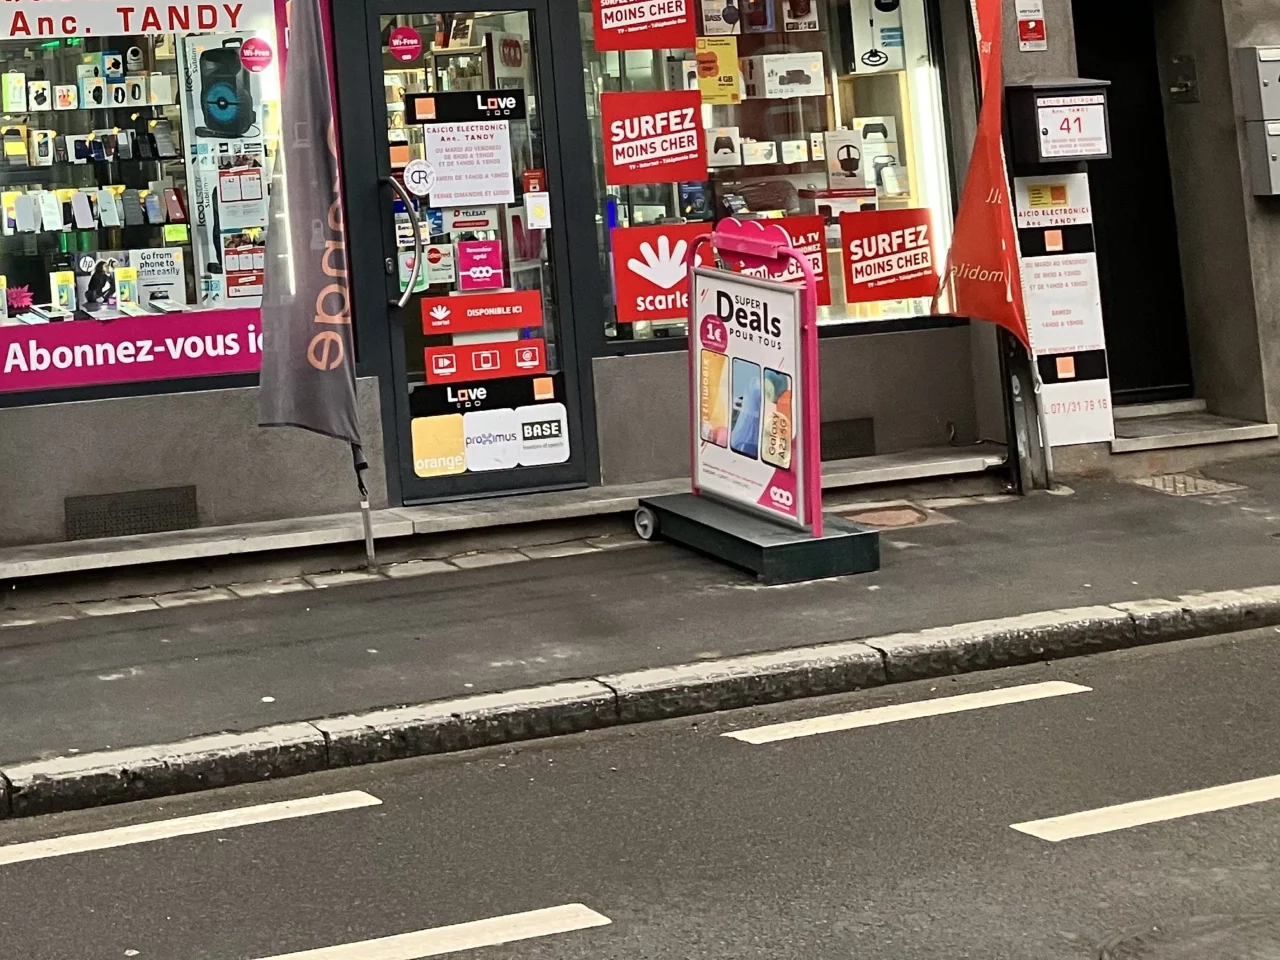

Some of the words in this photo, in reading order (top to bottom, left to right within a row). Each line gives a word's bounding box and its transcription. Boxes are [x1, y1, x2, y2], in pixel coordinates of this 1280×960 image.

[9, 10, 92, 37] Anc.
[116, 3, 244, 31] TANDY
[604, 6, 646, 24] MOINS
[649, 0, 684, 16] CHER
[476, 95, 516, 110] Love
[426, 126, 454, 134] CASCIO
[456, 123, 507, 133] ELECTRONICS
[610, 107, 696, 143] SURFEZ
[1059, 117, 1083, 134] 41
[615, 141, 657, 161] MOINS
[661, 134, 695, 152] CHER
[1018, 209, 1039, 218] ASCIO
[1042, 207, 1089, 216] ELECTRONICS
[1049, 217, 1077, 225] TANDY
[807, 231, 820, 242] TV
[849, 224, 930, 261] SURFEZ
[81, 256, 94, 272] hp
[140, 252, 152, 260] Go
[152, 251, 172, 260] from
[139, 260, 164, 270] phone
[157, 266, 181, 276] easily
[787, 257, 820, 277] CHR
[854, 258, 894, 280] MOINS
[897, 251, 930, 270] CHER
[636, 290, 688, 311] scarle
[735, 294, 761, 310] SUPER
[466, 305, 511, 317] DISPONIBLE
[512, 305, 523, 314] ICI
[716, 290, 782, 338] Deals
[706, 323, 722, 342] 1€
[729, 327, 754, 342] POUR
[757, 335, 782, 351] TOUS
[3, 332, 241, 374] Abonnez-vous
[446, 387, 487, 403] Love
[1050, 401, 1081, 414] 071/31
[523, 422, 560, 438] BASE
[768, 411, 780, 457] Galaxy
[779, 418, 788, 436] 5G
[465, 431, 517, 447] proximus
[415, 455, 463, 472] orange
